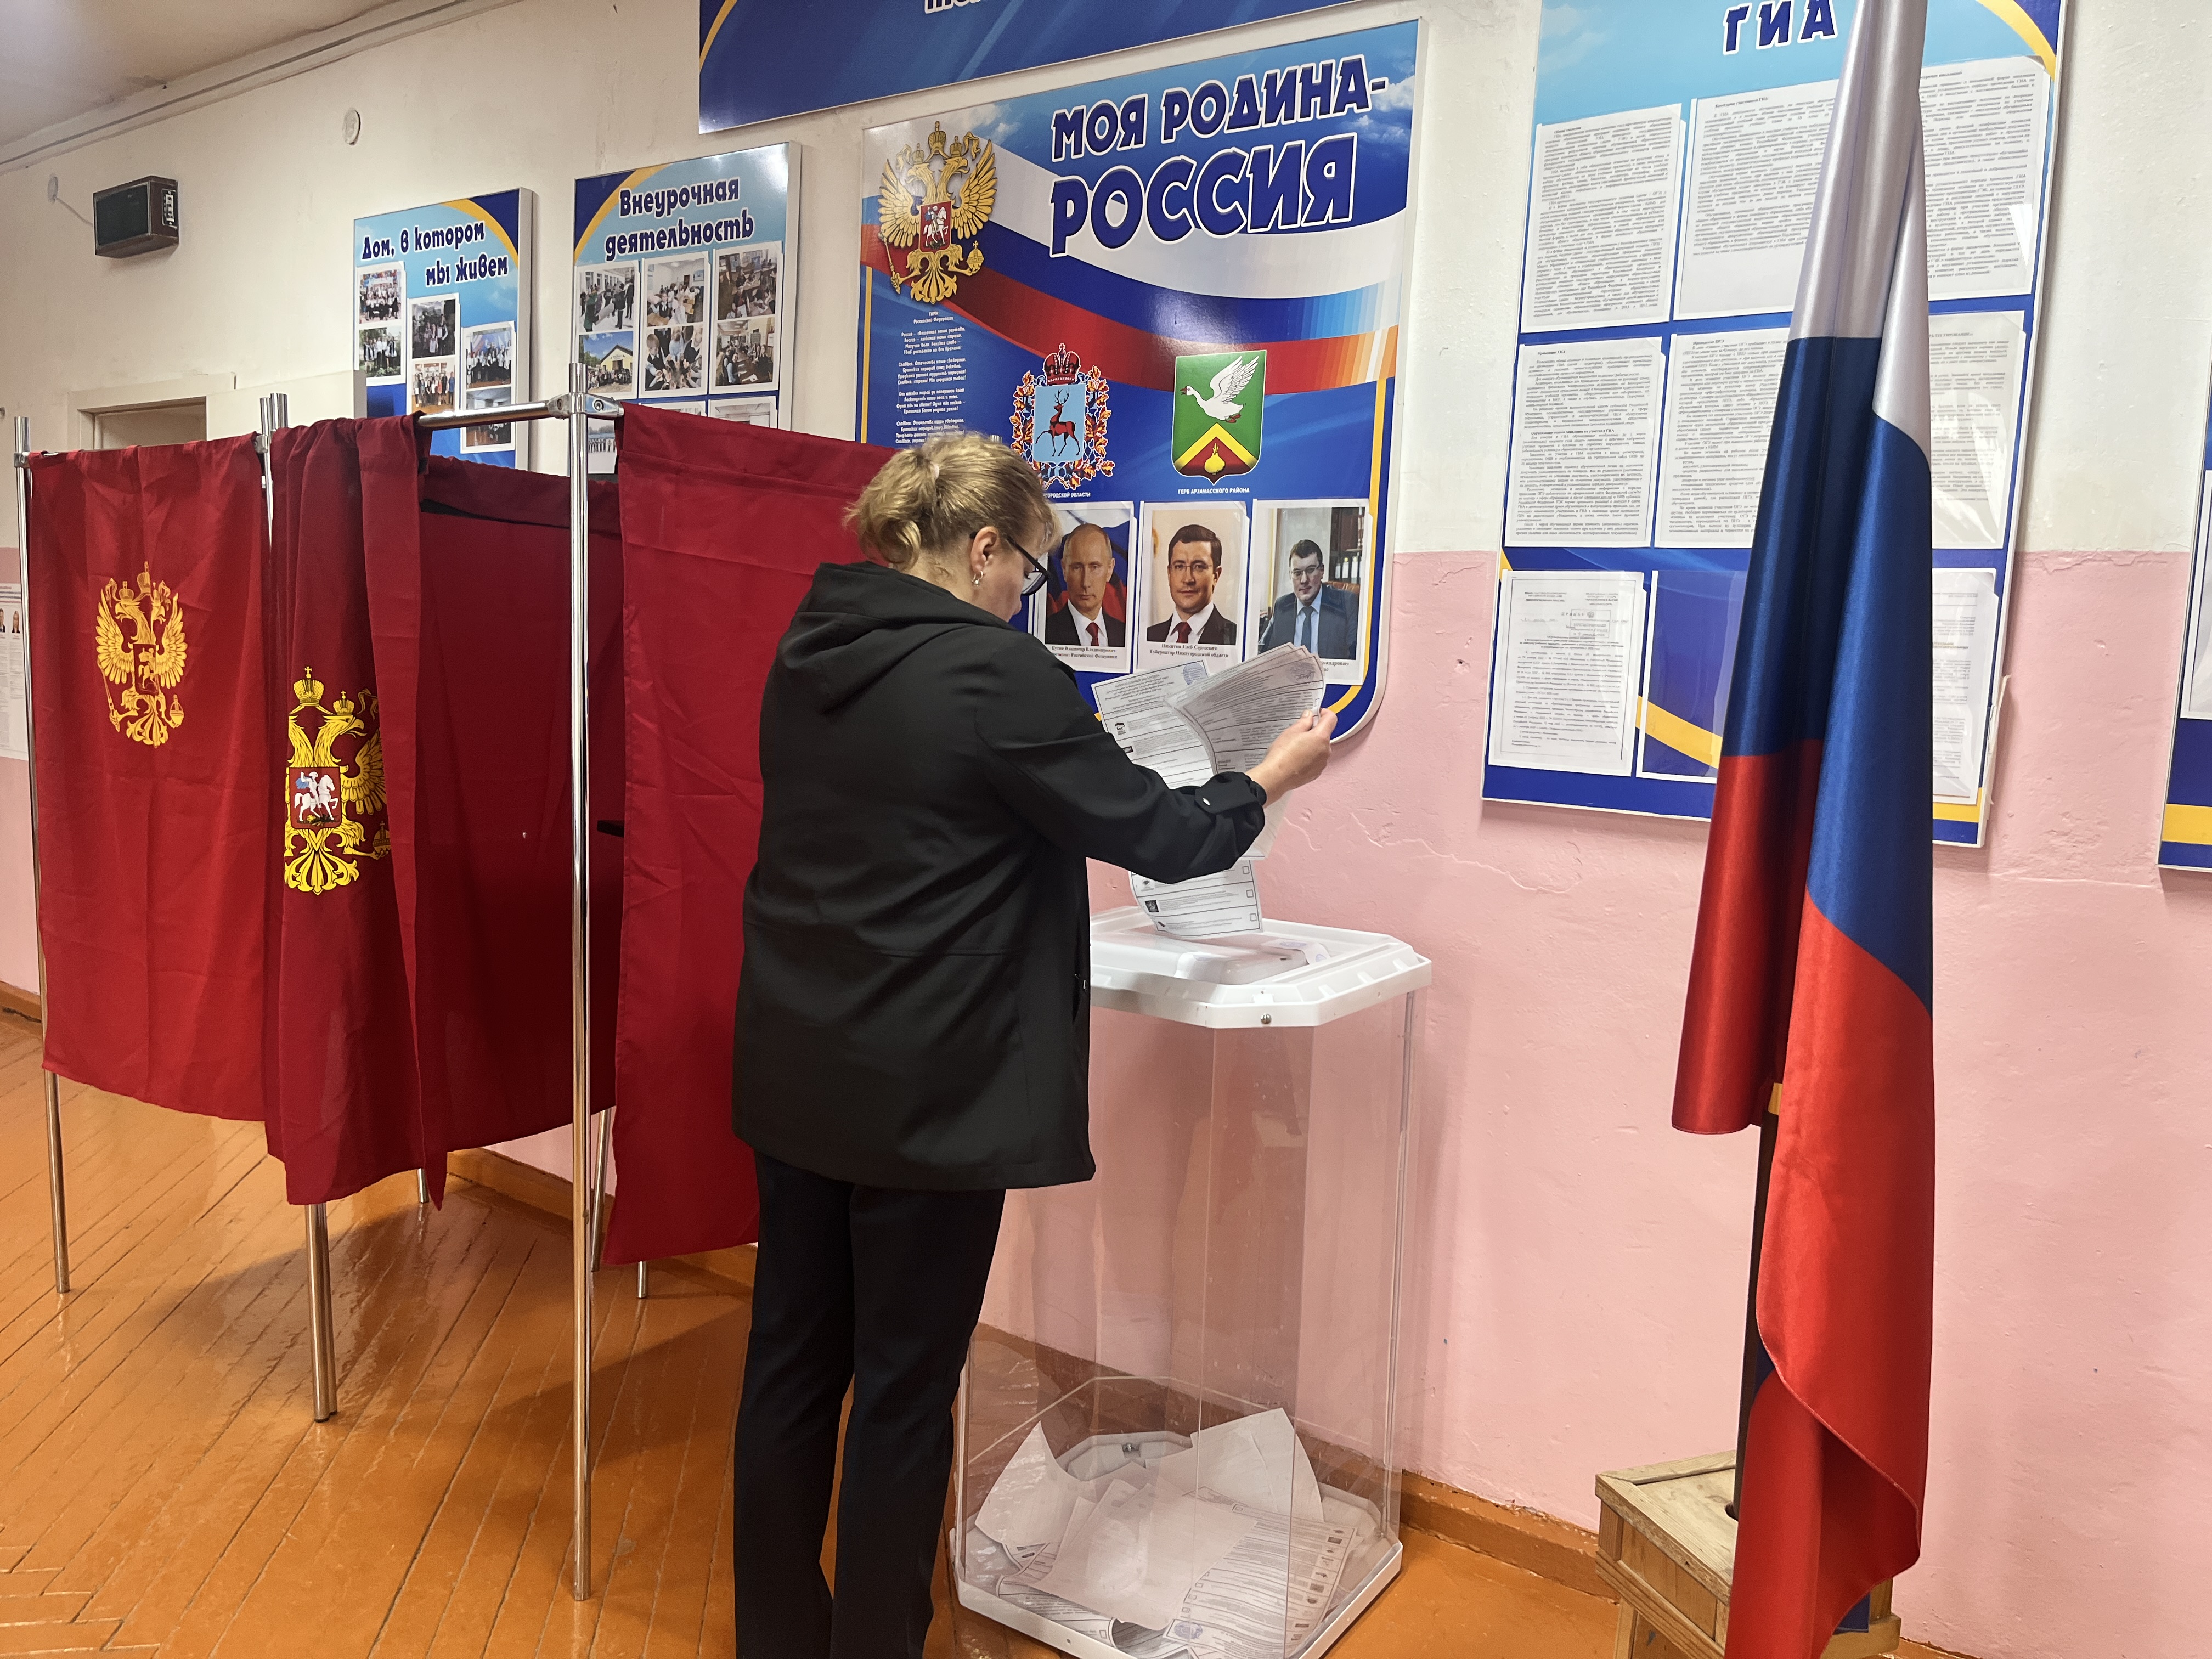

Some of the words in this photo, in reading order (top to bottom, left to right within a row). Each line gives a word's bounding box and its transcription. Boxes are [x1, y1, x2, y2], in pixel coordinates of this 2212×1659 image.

[1724, 0, 1837, 54] ГИА
[1052, 93, 1148, 162] МОЯ
[1161, 54, 1389, 144] РОДИНА-
[619, 178, 740, 217] Внеурочная
[1050, 132, 1357, 257] РОССИЯ
[362, 236, 395, 259] Дом,
[400, 229, 409, 252] в
[414, 222, 485, 251] котором
[605, 208, 754, 262] деятельность
[426, 258, 450, 286] мы
[455, 253, 508, 282] живем
